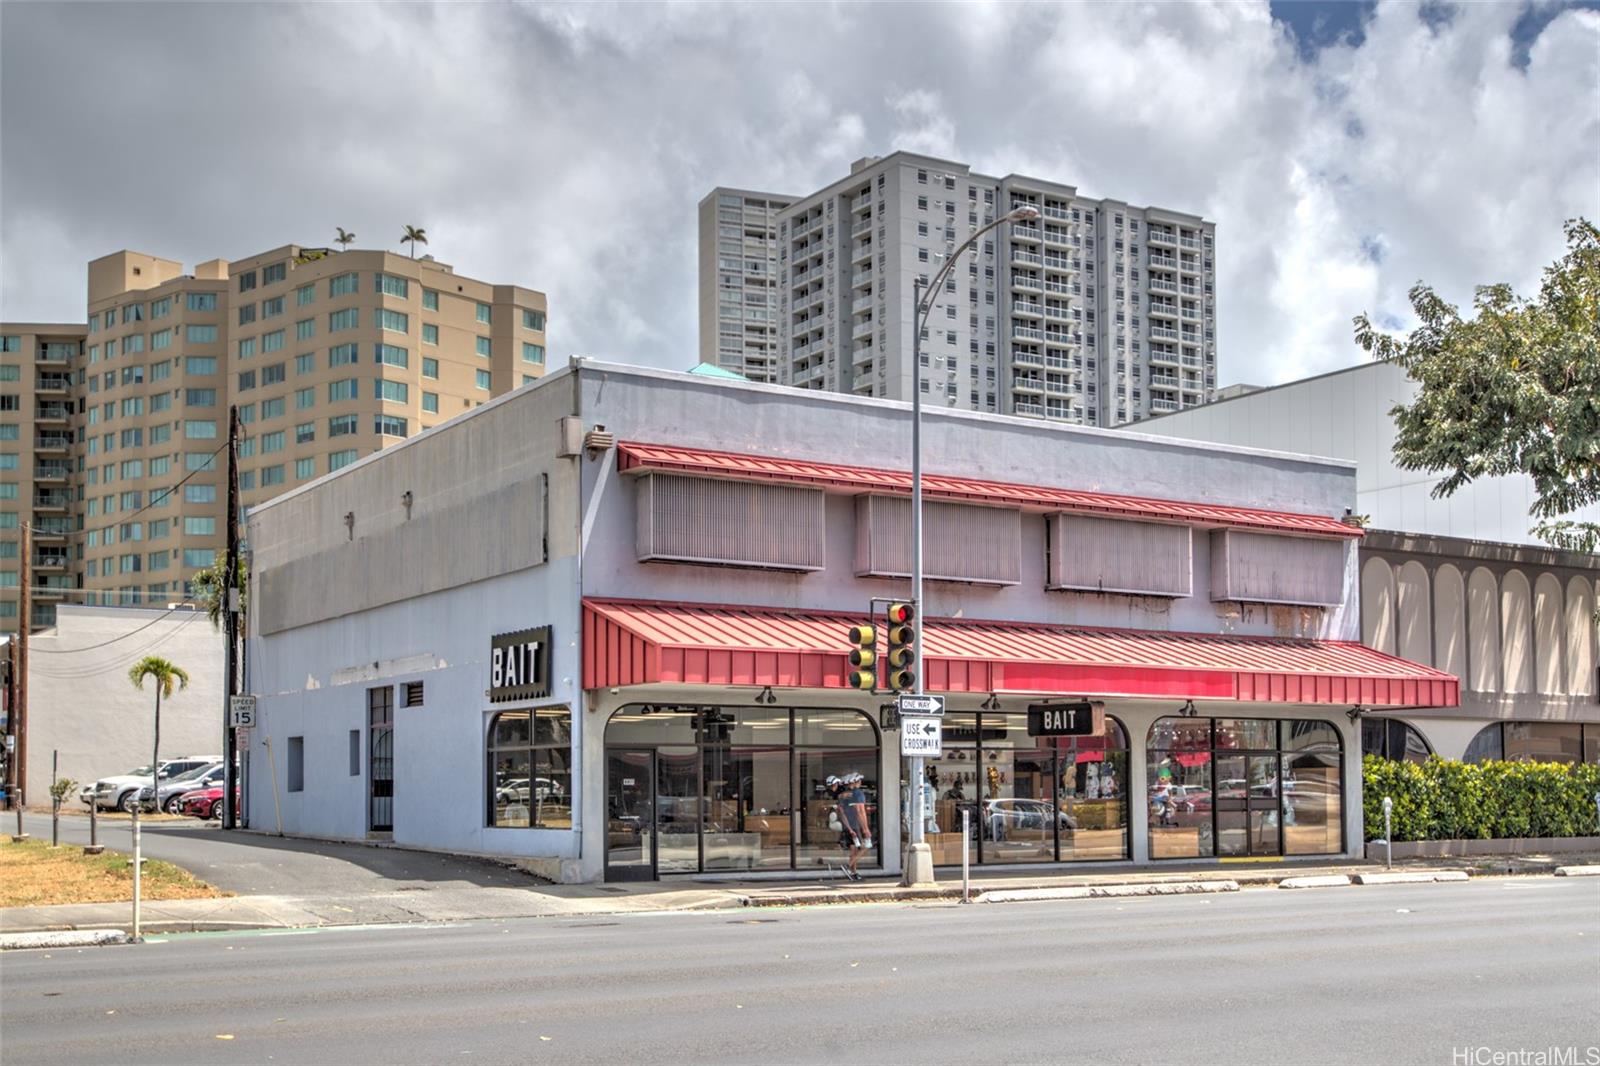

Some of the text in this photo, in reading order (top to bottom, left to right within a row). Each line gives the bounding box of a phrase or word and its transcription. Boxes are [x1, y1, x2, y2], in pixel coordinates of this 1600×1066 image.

[492, 641, 539, 688] BAIT
[235, 712, 251, 724] 15
[1043, 710, 1077, 730] BAIT
[906, 723, 920, 735] USE
[903, 738, 939, 750] CROSSWALK
